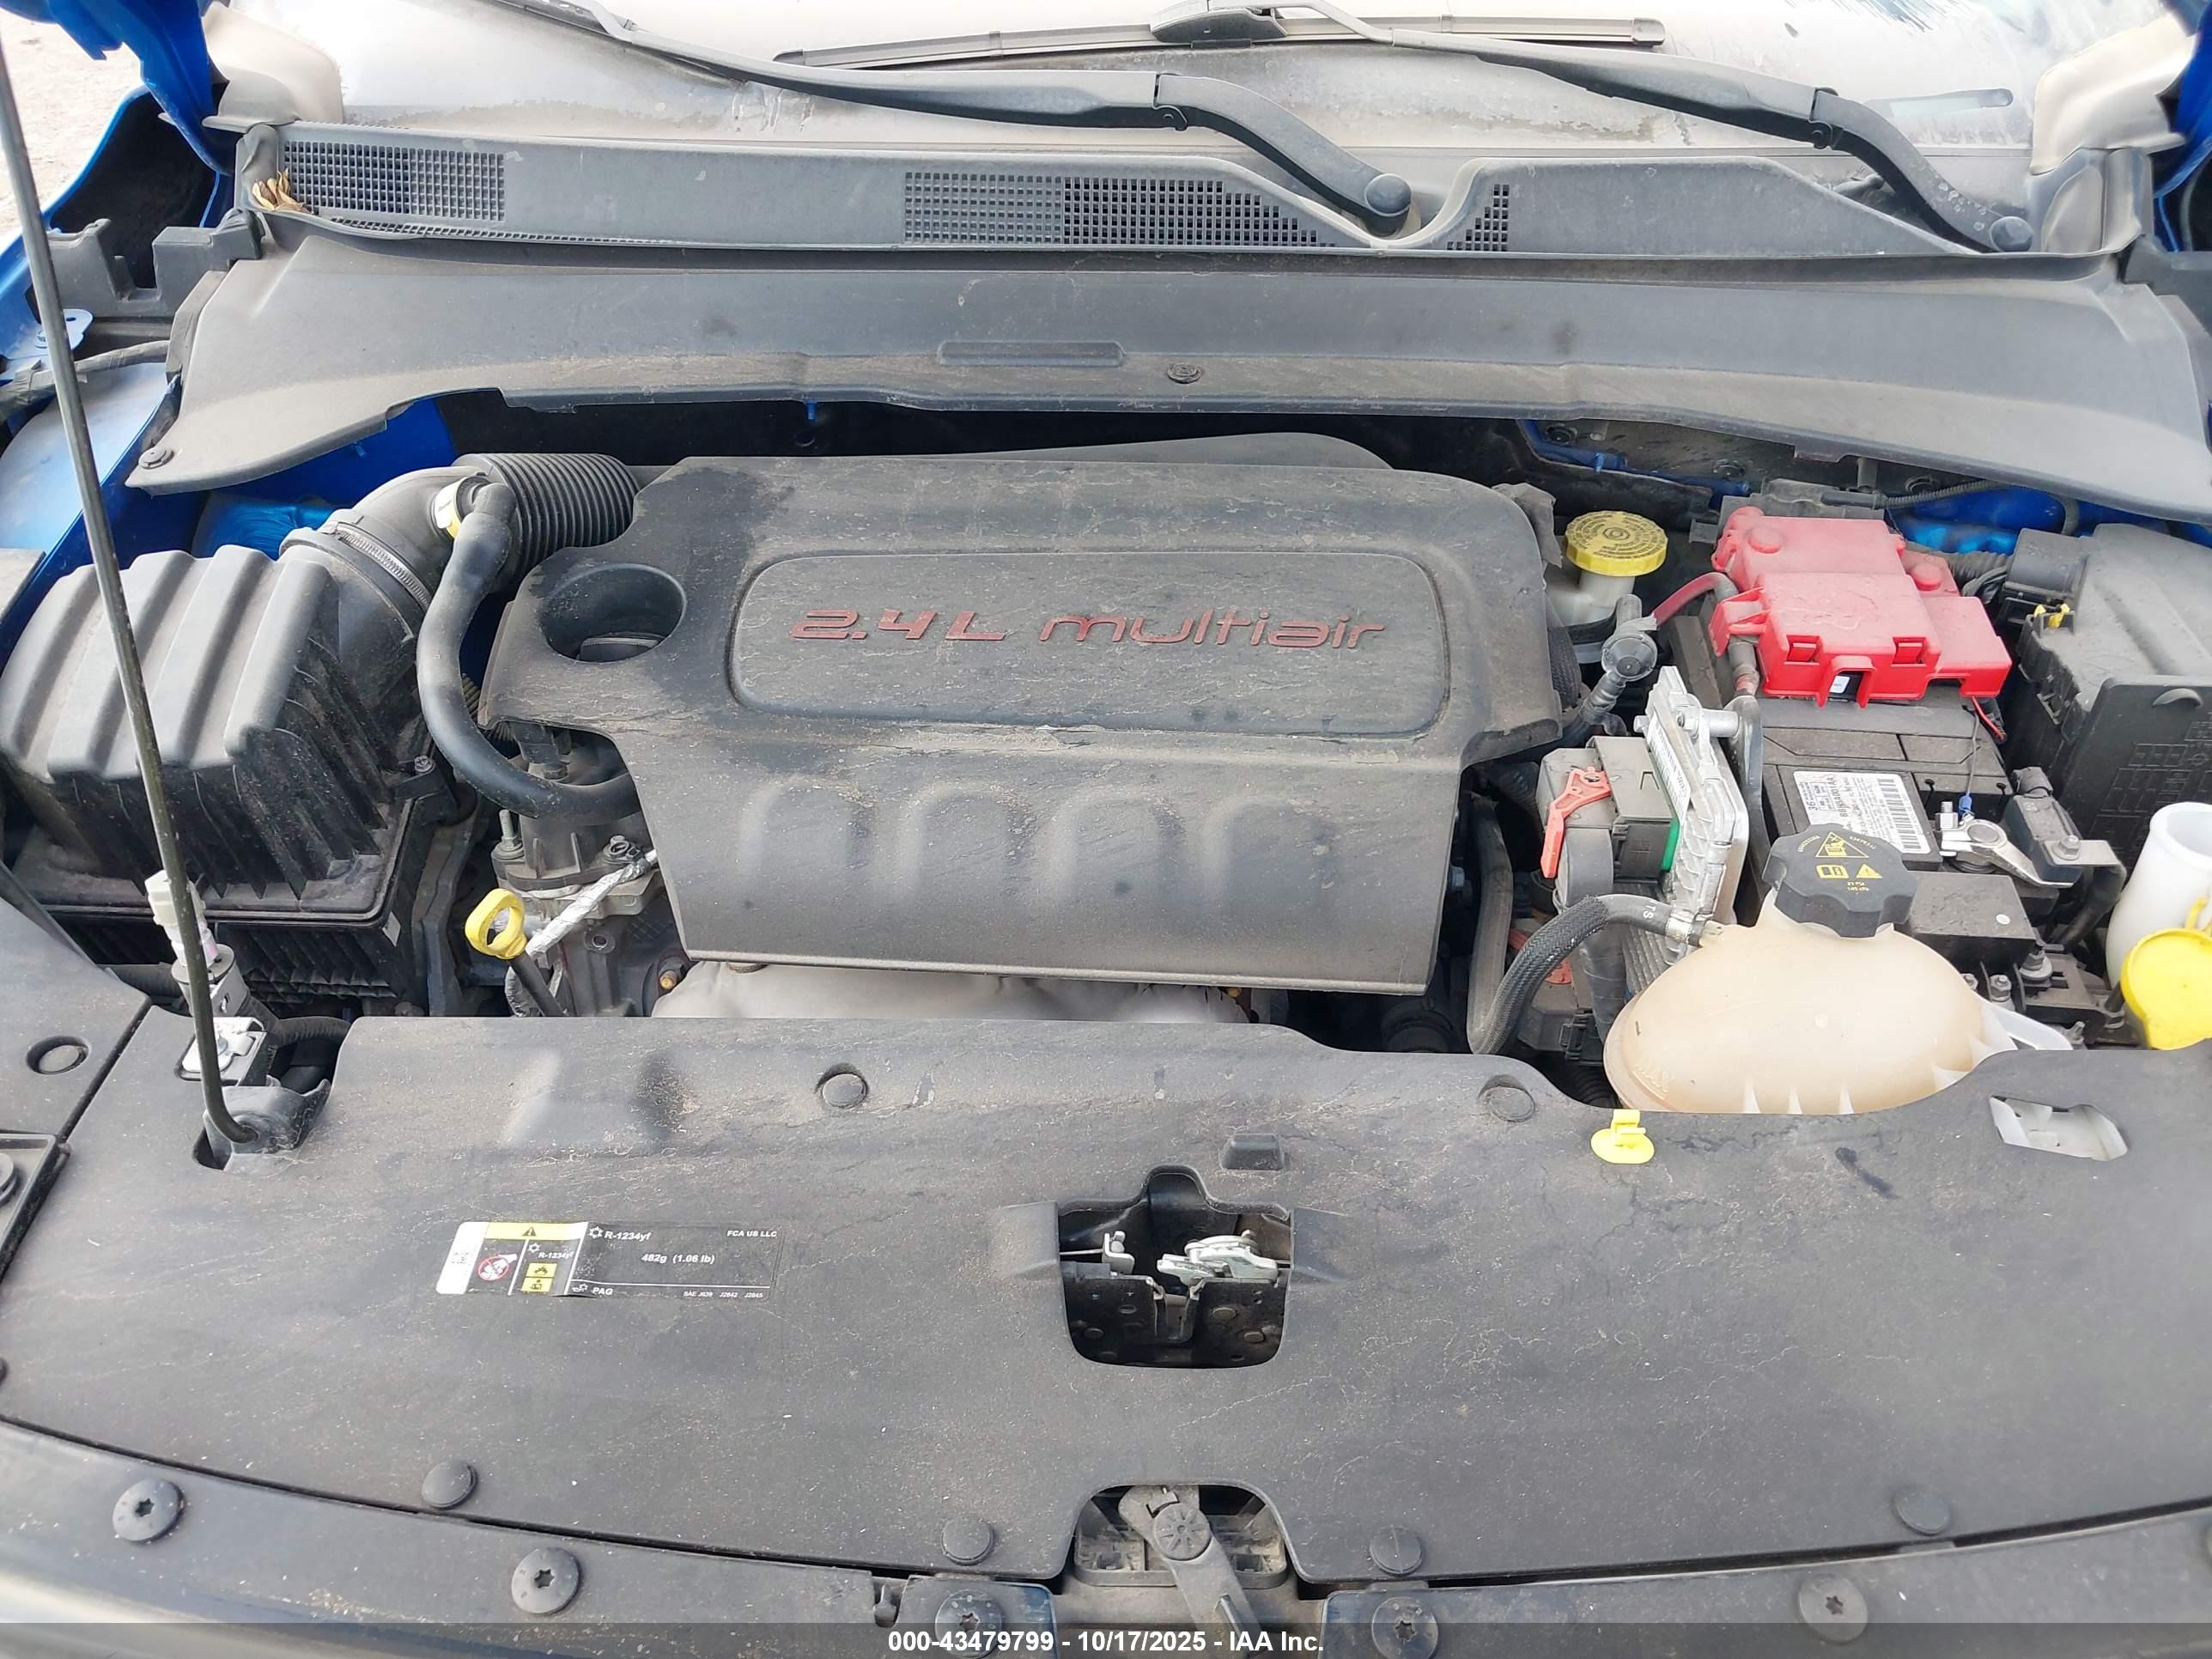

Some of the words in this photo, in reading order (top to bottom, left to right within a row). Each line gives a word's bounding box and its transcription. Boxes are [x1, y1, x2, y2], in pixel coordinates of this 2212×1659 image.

[1037, 608, 1384, 650] multiair
[604, 1230, 652, 1243] R-1234yf
[538, 1250, 574, 1260] R-1234yf
[641, 1253, 667, 1264] 482g
[672, 1254, 698, 1264] (1.06
[700, 1254, 716, 1265] lb)
[592, 1287, 613, 1296] PAG
